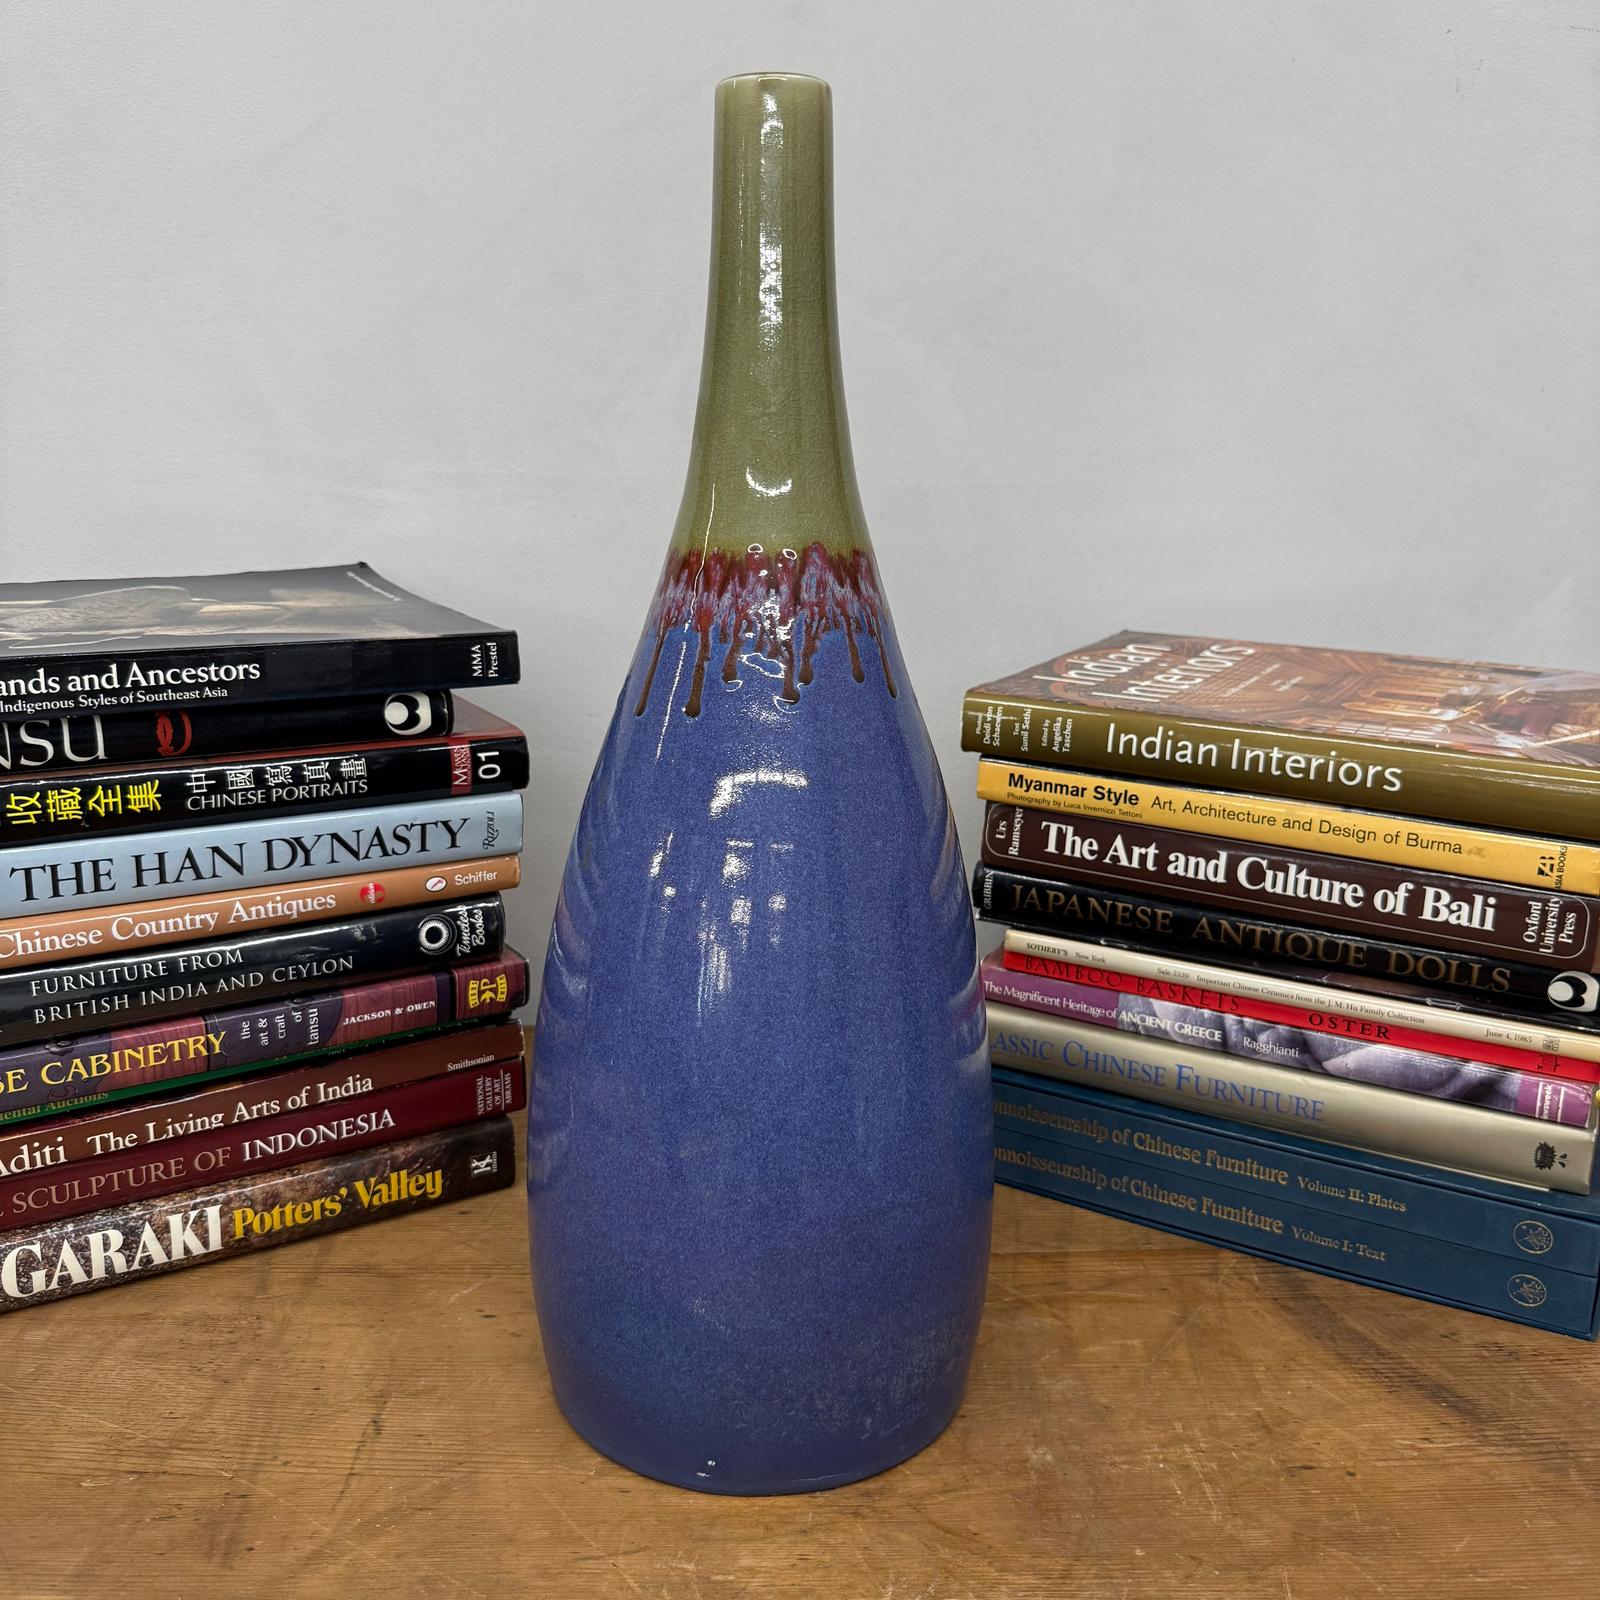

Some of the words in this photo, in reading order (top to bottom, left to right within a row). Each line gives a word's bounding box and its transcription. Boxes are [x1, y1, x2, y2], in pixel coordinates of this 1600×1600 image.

[67, 663, 120, 692] and
[124, 662, 261, 689] Ancestors
[472, 644, 482, 677] MMA
[487, 642, 498, 677] Prestel
[1032, 643, 1171, 686] Indian
[1091, 644, 1255, 703] Interiors
[0, 699, 75, 714] Indigenous
[79, 693, 118, 709] Styles
[121, 692, 134, 704] of
[137, 688, 200, 703] Southeast
[203, 687, 228, 698] Asia
[1022, 708, 1032, 730] Sethi
[1021, 731, 1029, 752] Sunil
[1052, 717, 1063, 752] Angelika
[1062, 718, 1073, 752] Taschen
[477, 751, 501, 779] 01
[1107, 722, 1217, 767] Indian
[1230, 738, 1402, 793] Interiors
[187, 790, 266, 810] CHINESE
[271, 779, 368, 802] PORTRAITS
[1007, 793, 1051, 807] Photography
[1063, 801, 1081, 810] Luca
[1008, 772, 1087, 799] Myanmar
[1092, 785, 1139, 806] Style
[1151, 796, 1176, 814] Art,
[1182, 800, 1277, 827] Architecture
[1282, 817, 1312, 831] and
[1319, 819, 1376, 843] Design
[1383, 830, 1401, 845] of
[1406, 833, 1462, 855] Burma
[995, 820, 1007, 839] Urs
[1008, 807, 1024, 856] Ramseyer
[9, 858, 116, 902] THE
[130, 842, 247, 888] HAN
[261, 818, 471, 872] DYNASTY
[454, 871, 498, 885] Schiffer
[1040, 821, 1099, 861] The
[1103, 834, 1159, 872] Art
[1167, 851, 1227, 883] and
[1237, 856, 1363, 908] Culture
[1374, 882, 1413, 916] of
[1419, 885, 1496, 932] Bali
[1557, 845, 1568, 873] BOOKS
[0, 930, 103, 958] Chinese
[111, 911, 219, 942] Country
[227, 893, 336, 925] Antiques
[471, 909, 486, 947] Books
[1012, 884, 1174, 935] JAPANESE
[1192, 915, 1367, 969] ANTIQUE
[1387, 949, 1511, 993] DOLLS
[1522, 901, 1542, 943] Oxford
[1539, 895, 1563, 953] University
[1558, 912, 1577, 943] Press
[30, 960, 169, 997] FURNITURE
[179, 948, 244, 974] FROM
[34, 994, 130, 1025] BRITISH
[140, 981, 208, 1006] INDIA
[215, 972, 264, 993] AND
[272, 955, 353, 984] CEYLON
[292, 1011, 302, 1022] of
[343, 1008, 392, 1026] JACKSON
[395, 1007, 404, 1015] &
[407, 1000, 436, 1013] OWEN
[1025, 955, 1122, 987] BAMBOO
[1136, 972, 1239, 1011] BASKETS
[1308, 1013, 1391, 1040] OSTER
[1196, 975, 1231, 989] Important
[1232, 982, 1260, 993] Chinese
[1261, 987, 1294, 1000] Ceramics
[1295, 993, 1313, 1003] from
[1314, 997, 1325, 1005] the
[1360, 1004, 1385, 1017] Family
[1386, 1010, 1425, 1024] Collection
[1484, 1029, 1501, 1038] June
[241, 1020, 251, 1039] the
[258, 1018, 268, 1028] &
[259, 1031, 269, 1046] art
[275, 1014, 286, 1039] craft
[308, 1008, 320, 1045] tansu
[984, 981, 1003, 995] The
[1004, 985, 1060, 1011] Magnificent
[1063, 997, 1105, 1018] Heritage
[1106, 1007, 1117, 1018] of
[1119, 1010, 1173, 1031] ANCIENT
[1175, 1022, 1222, 1042] GREECE
[1243, 1036, 1299, 1058] Ragghianti
[41, 1031, 226, 1086] CABINETRY
[447, 1054, 495, 1071] Smithsonian
[990, 1032, 1054, 1061] ASSIC
[1063, 1040, 1166, 1086] CHINESE
[1175, 1063, 1325, 1122] FURNITURE
[87, 1131, 138, 1155] The
[146, 1112, 225, 1143] Living
[232, 1100, 280, 1124] Arts
[288, 1086, 311, 1109] of
[317, 1074, 374, 1100] India
[12, 1157, 187, 1214] SCULPTURE
[194, 1147, 231, 1171] OF
[242, 1109, 396, 1161] INDONESIA
[1112, 1130, 1131, 1145] of
[1133, 1132, 1201, 1163] Chinese
[1205, 1150, 1288, 1185] Furniture
[1297, 1176, 1346, 1198] Volume
[1368, 1193, 1407, 1212] Plates
[2, 1204, 225, 1298] GARAKI
[353, 1168, 443, 1210] Valley
[1111, 1177, 1131, 1192] of
[1130, 1178, 1197, 1210] Chinese
[1201, 1197, 1284, 1235] Furniture
[1291, 1226, 1340, 1249] Volume
[1356, 1243, 1387, 1261] Text
